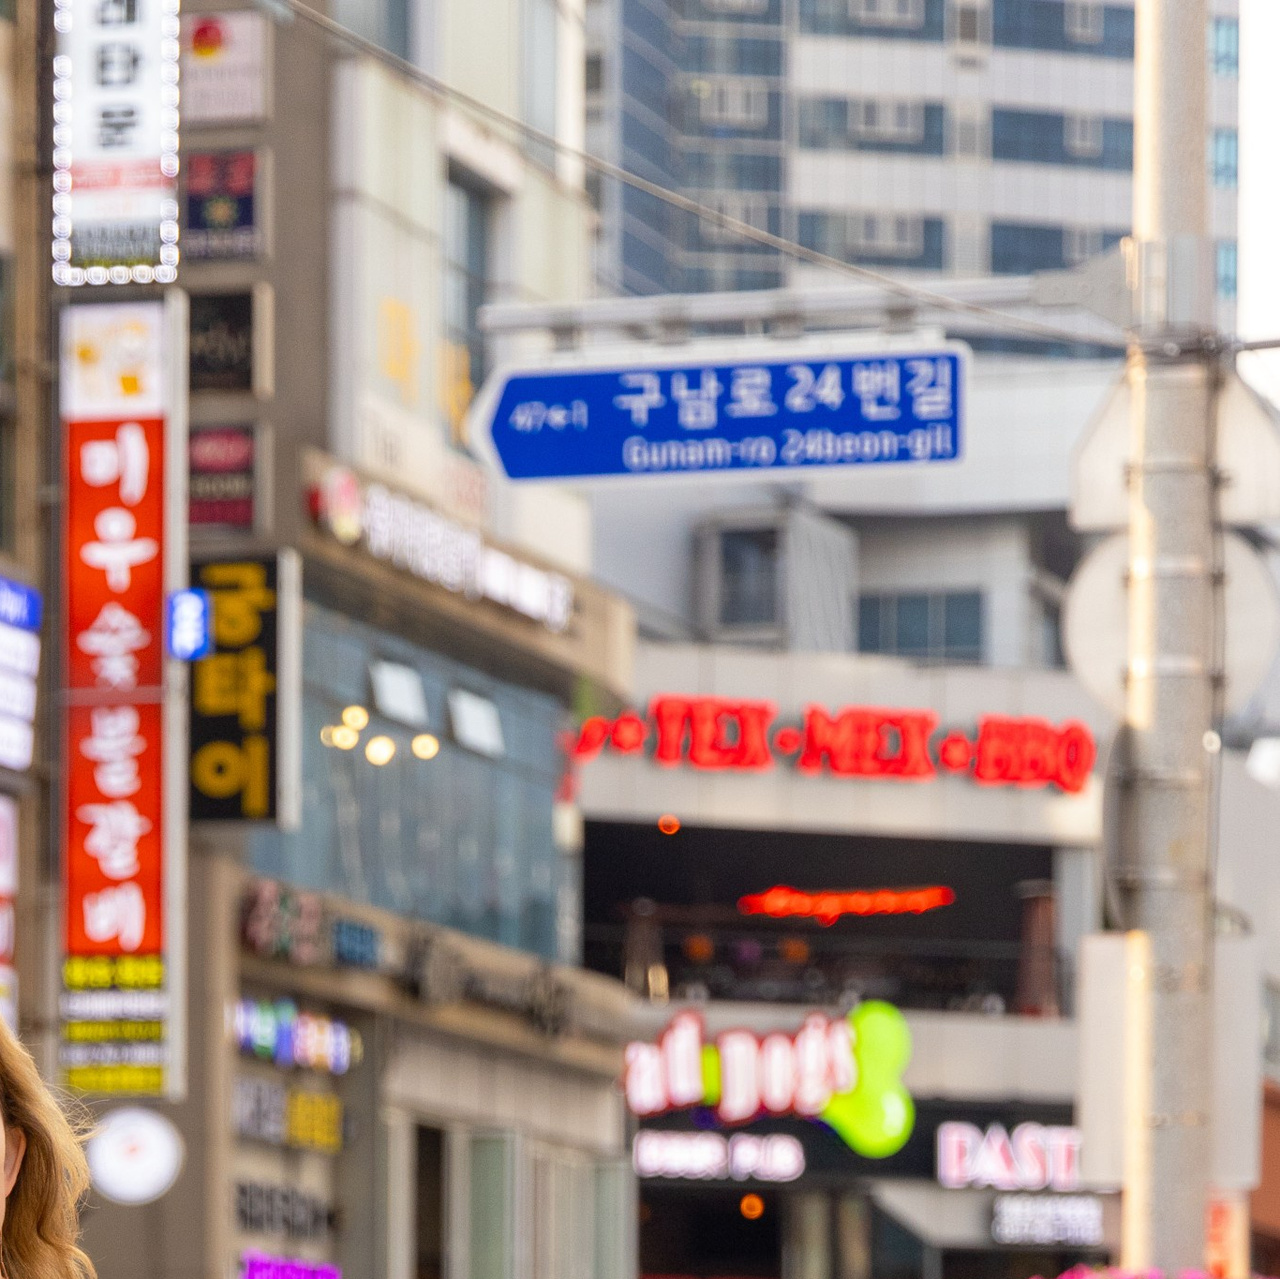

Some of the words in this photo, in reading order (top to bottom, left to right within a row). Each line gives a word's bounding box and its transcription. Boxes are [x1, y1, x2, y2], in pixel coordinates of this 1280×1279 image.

[613, 368, 778, 429] 구남로
[800, 705, 937, 780] MEX
[936, 1120, 1084, 1192] PAST
